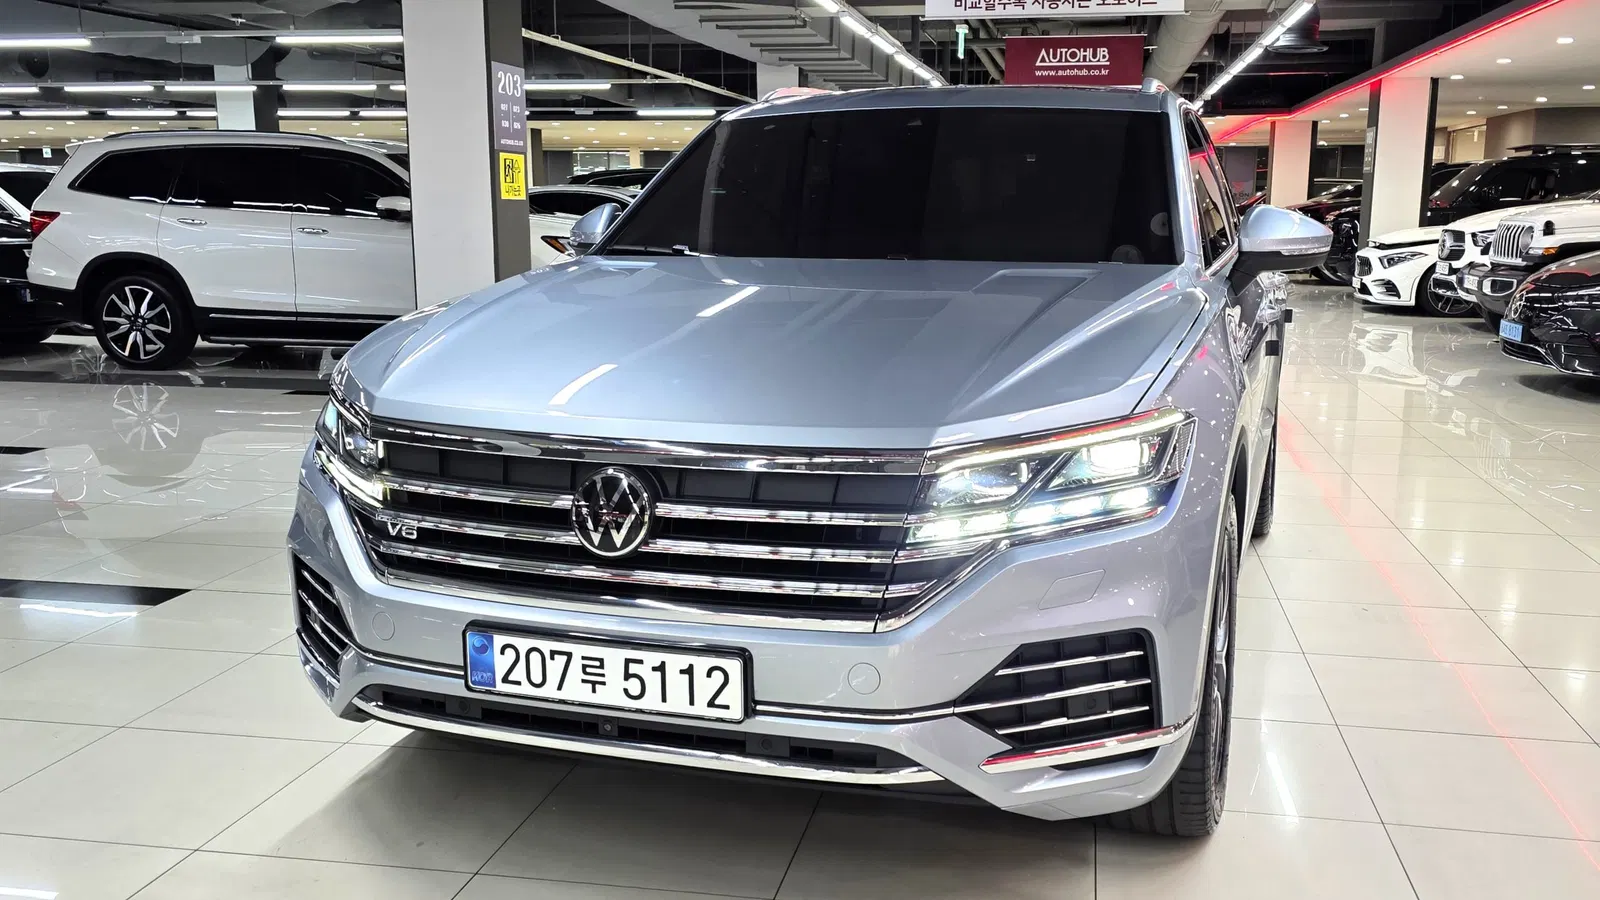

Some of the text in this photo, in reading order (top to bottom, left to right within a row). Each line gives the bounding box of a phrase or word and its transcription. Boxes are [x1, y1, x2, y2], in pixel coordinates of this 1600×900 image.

[1035, 47, 1110, 65] AUTOHUB
[1034, 68, 1109, 76] www.autohub.co.kr
[497, 70, 522, 98] 203
[386, 521, 418, 540] V6
[499, 642, 731, 711] 207루 5112
